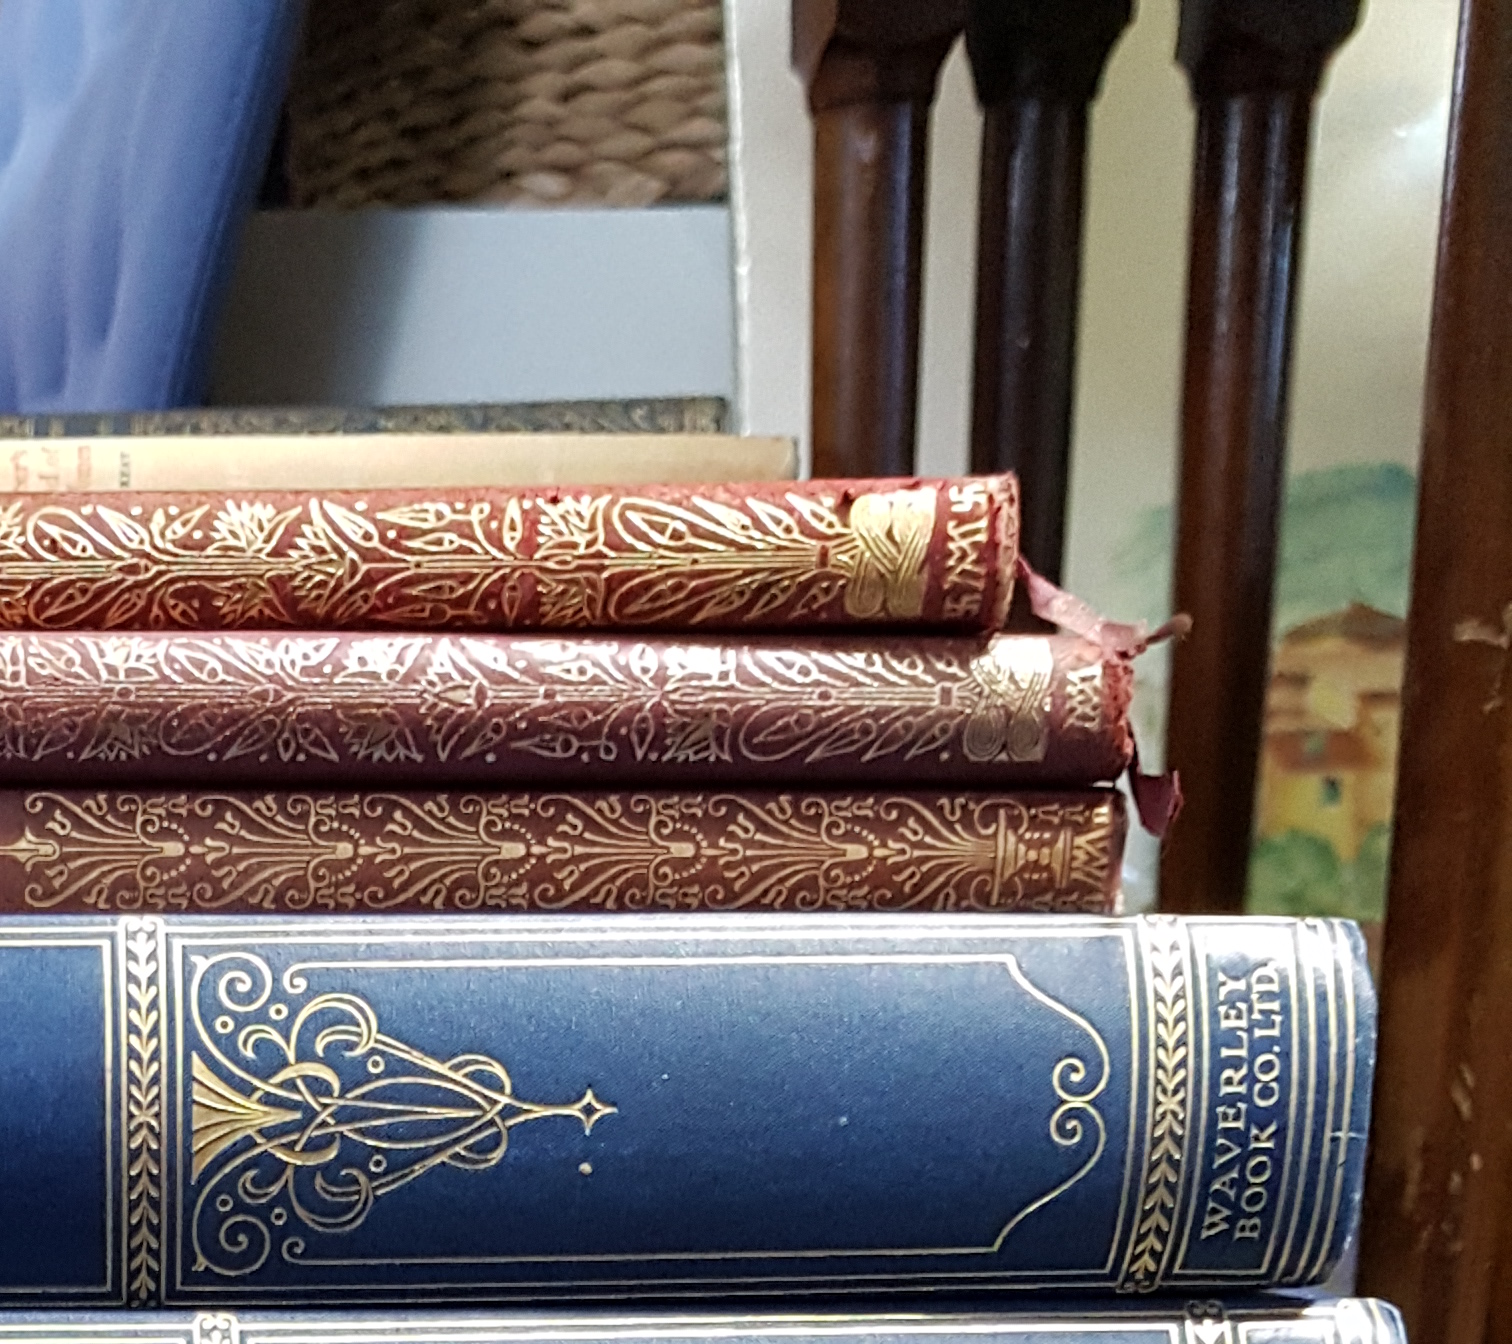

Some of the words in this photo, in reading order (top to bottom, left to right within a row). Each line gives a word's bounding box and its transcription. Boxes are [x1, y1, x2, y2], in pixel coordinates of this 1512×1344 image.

[1251, 960, 1282, 1038] LTD.
[1200, 973, 1249, 1239] WAVERLEY
[1252, 1046, 1281, 1107] CO.
[1233, 1121, 1278, 1240] BOOK
